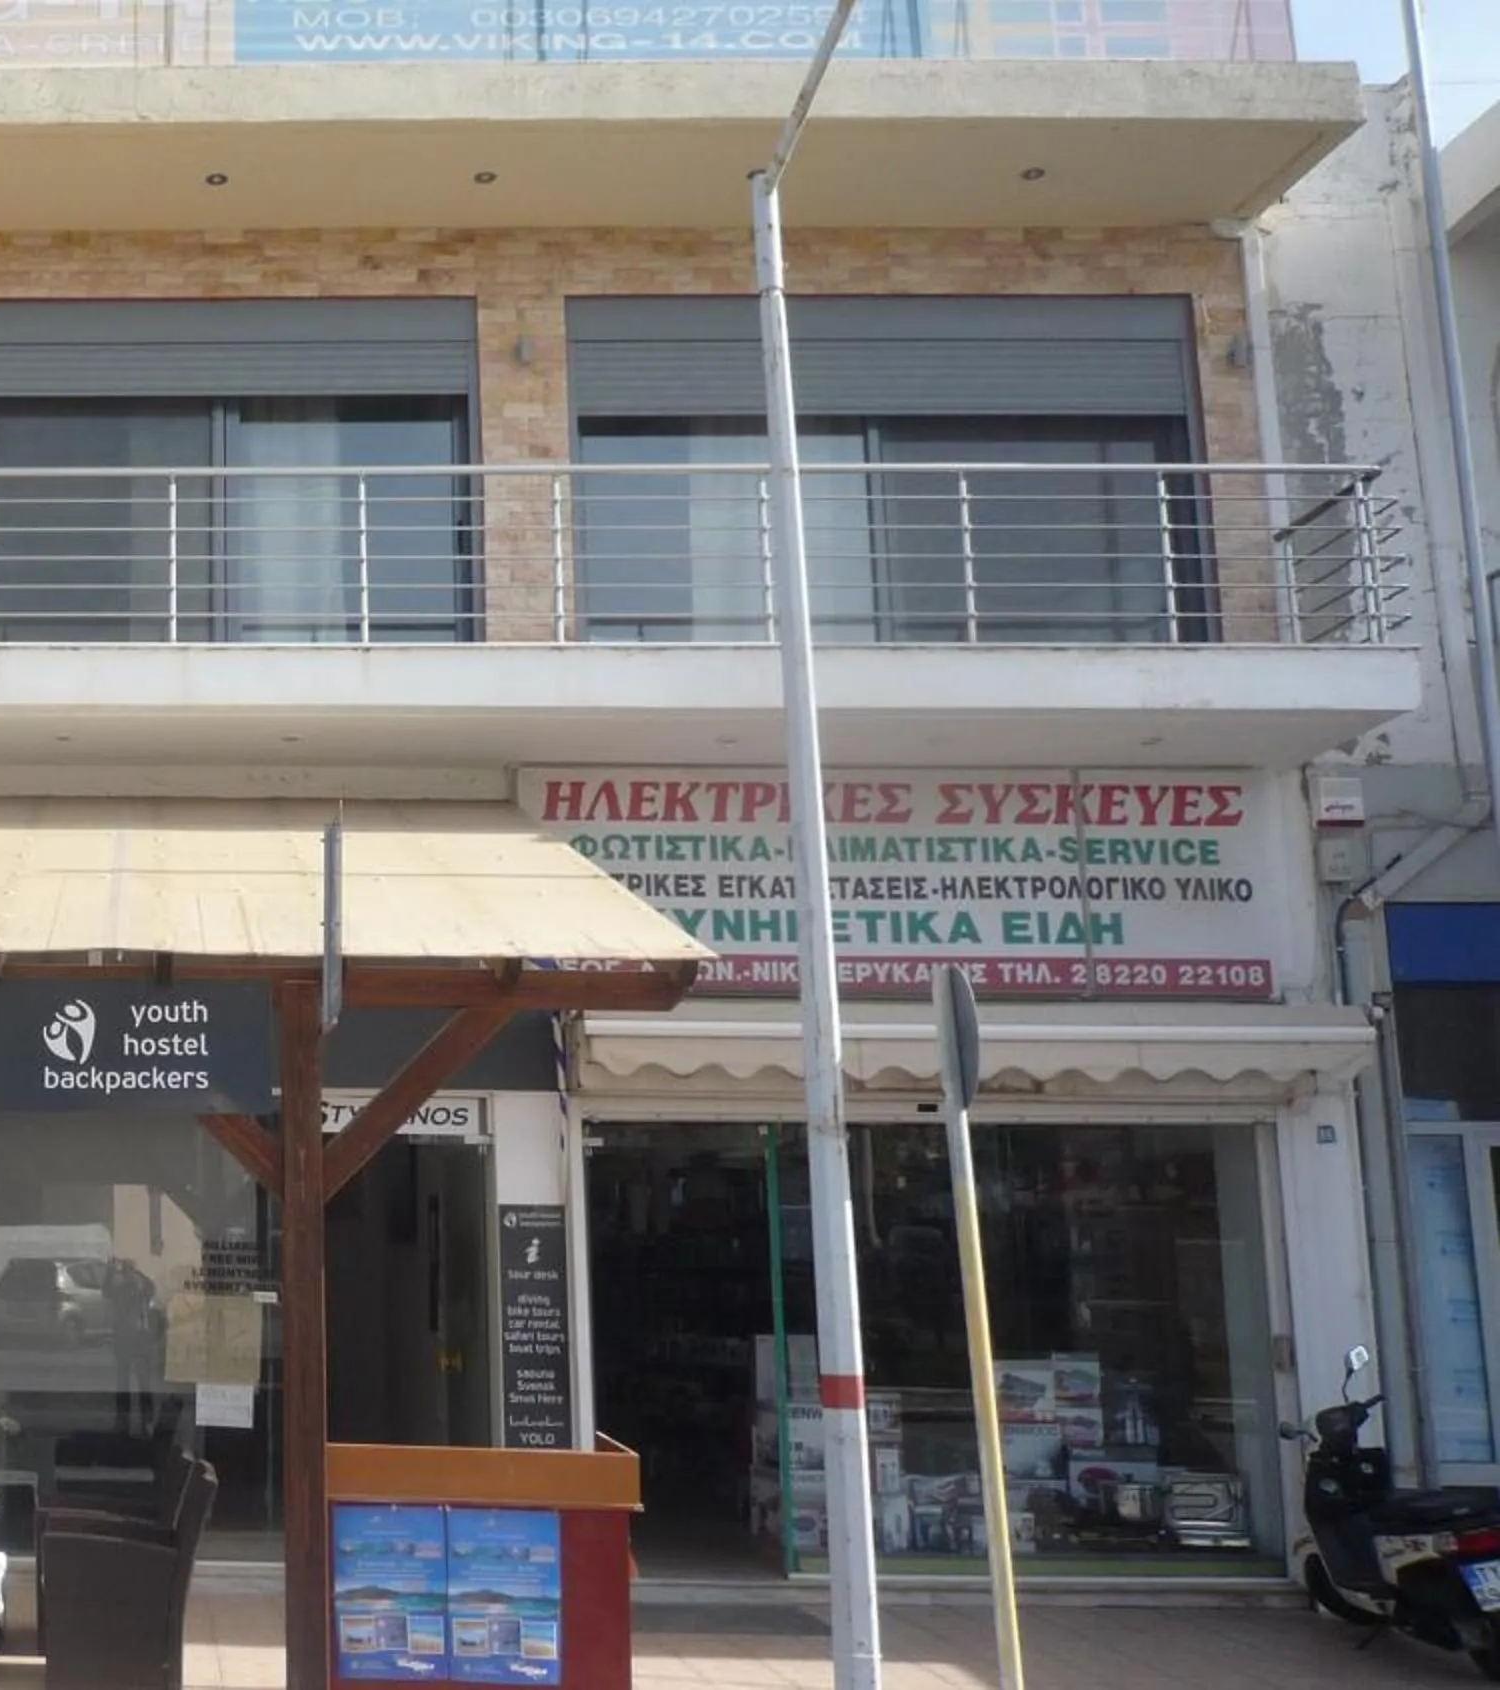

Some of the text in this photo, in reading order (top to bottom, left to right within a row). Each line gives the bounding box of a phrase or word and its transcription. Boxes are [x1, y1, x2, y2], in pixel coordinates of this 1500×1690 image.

[935, 782, 1244, 828] ΣΥΣΚΕΥΕΣ
[1175, 877, 1254, 903] ΥΛΙΚΟ
[1002, 911, 1124, 946] ΕΙΔΗ
[1178, 965, 1266, 987] 22108
[131, 1001, 208, 1028] youth
[123, 1033, 209, 1057] hostel
[43, 1066, 210, 1095] backpackers
